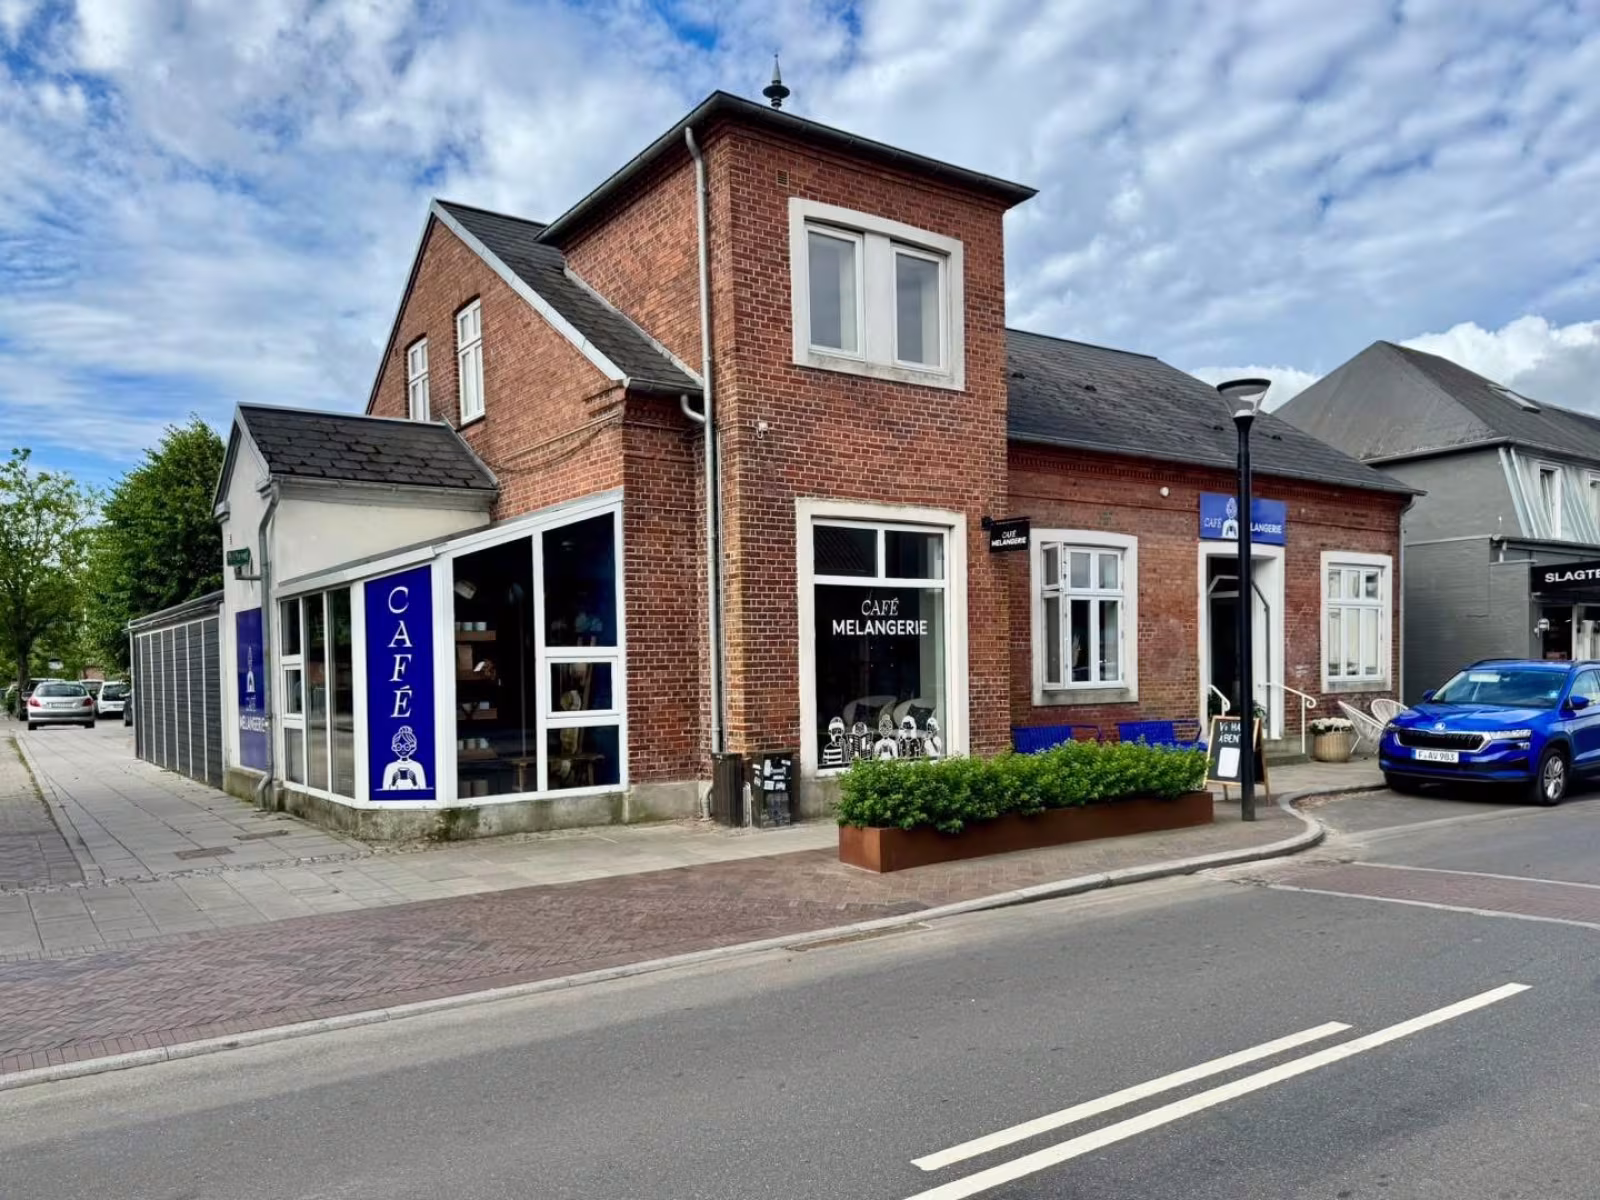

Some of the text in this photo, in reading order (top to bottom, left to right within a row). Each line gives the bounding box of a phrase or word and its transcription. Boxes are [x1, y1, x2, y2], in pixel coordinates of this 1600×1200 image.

[1250, 522, 1282, 534] LANGERIE
[861, 597, 899, 616] CAFÉ
[832, 619, 928, 635] MELANGERIE
[388, 585, 413, 718] CAFÉ
